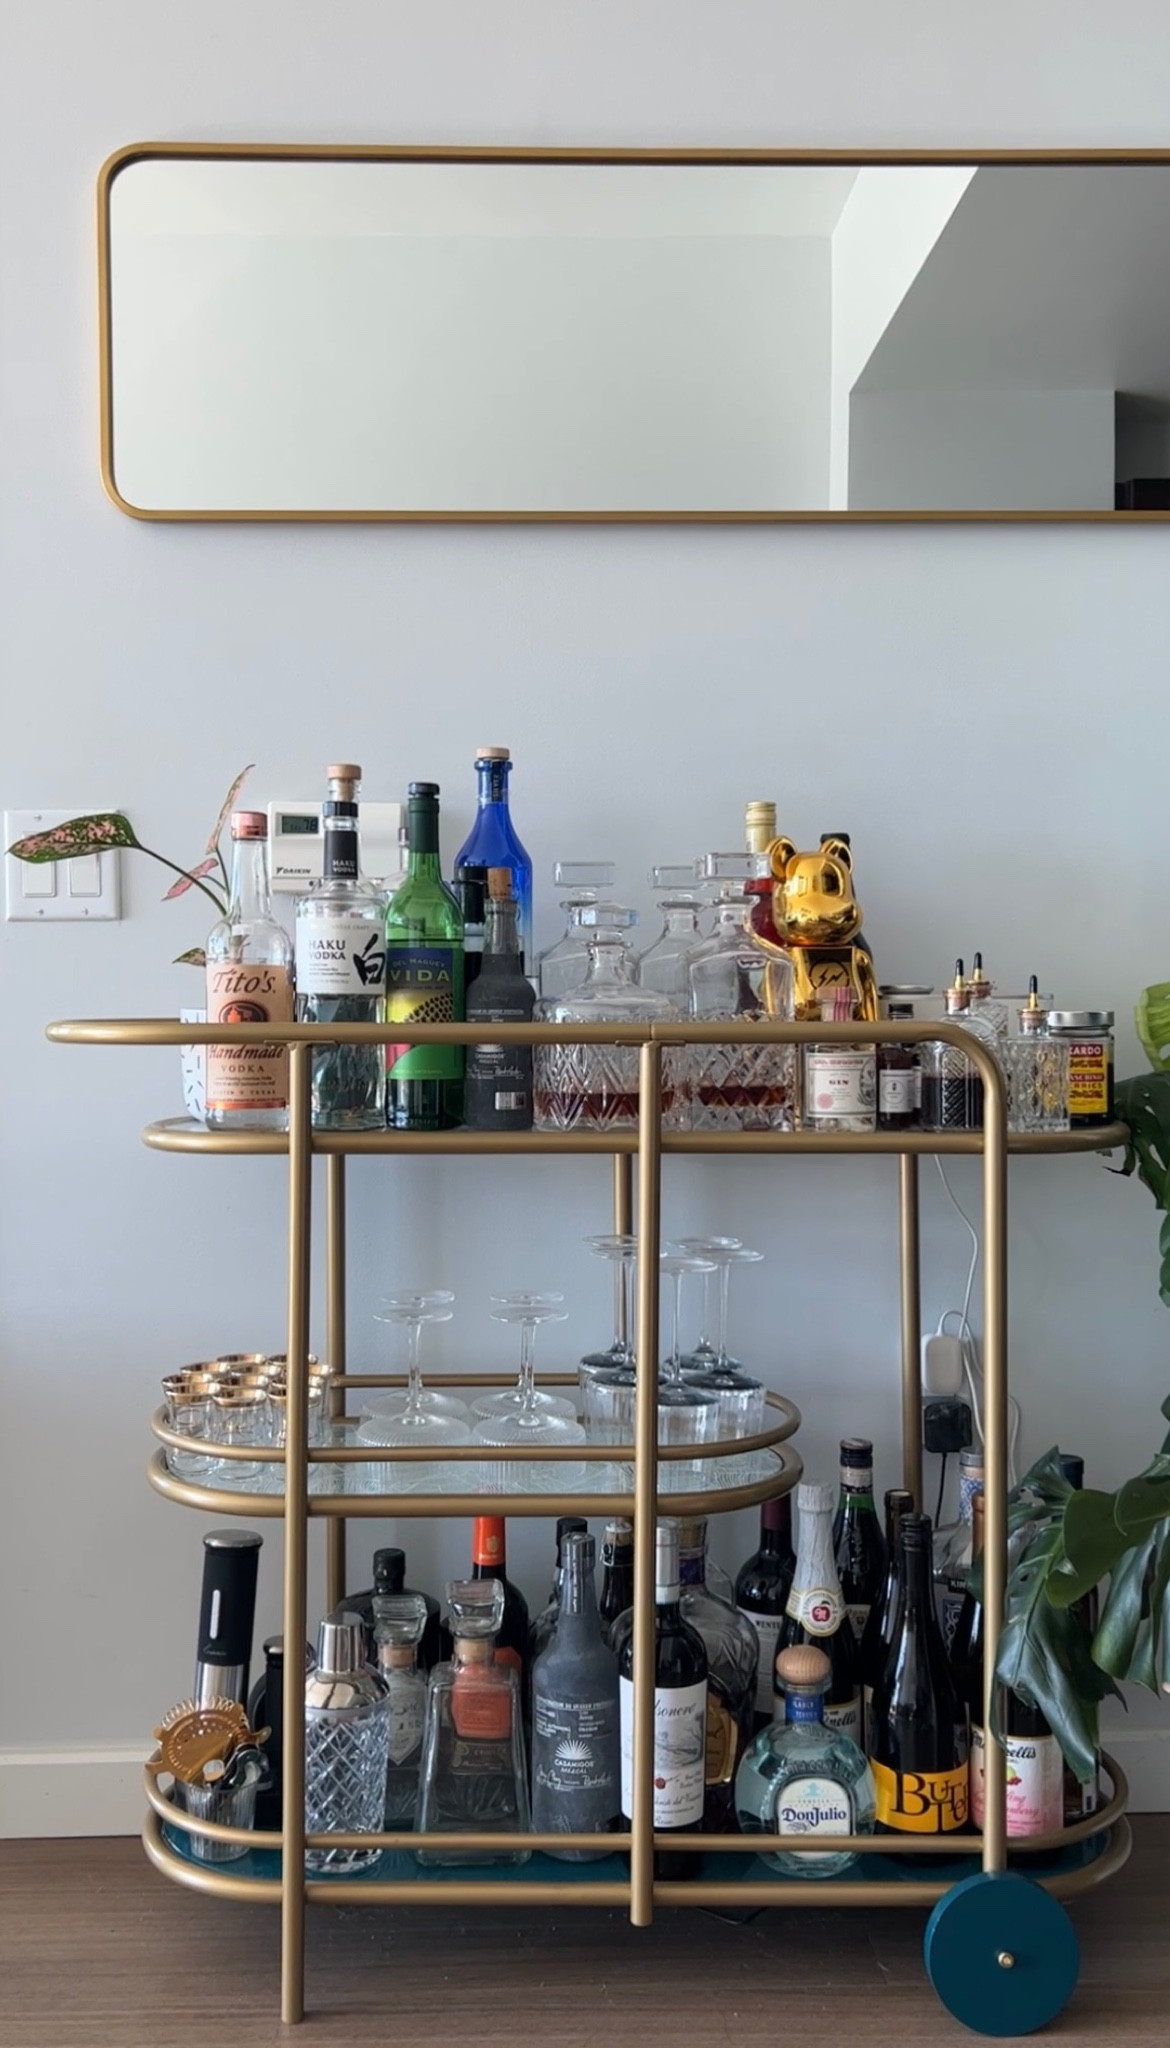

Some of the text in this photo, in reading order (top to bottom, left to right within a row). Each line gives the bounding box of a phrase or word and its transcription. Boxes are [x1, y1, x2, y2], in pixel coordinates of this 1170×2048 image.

[309, 939, 346, 951] HAKU
[309, 951, 347, 960] VODKA
[390, 970, 450, 981] VIDA
[221, 1065, 265, 1073] VODKA
[554, 1759, 594, 1768] CASAMIGOS
